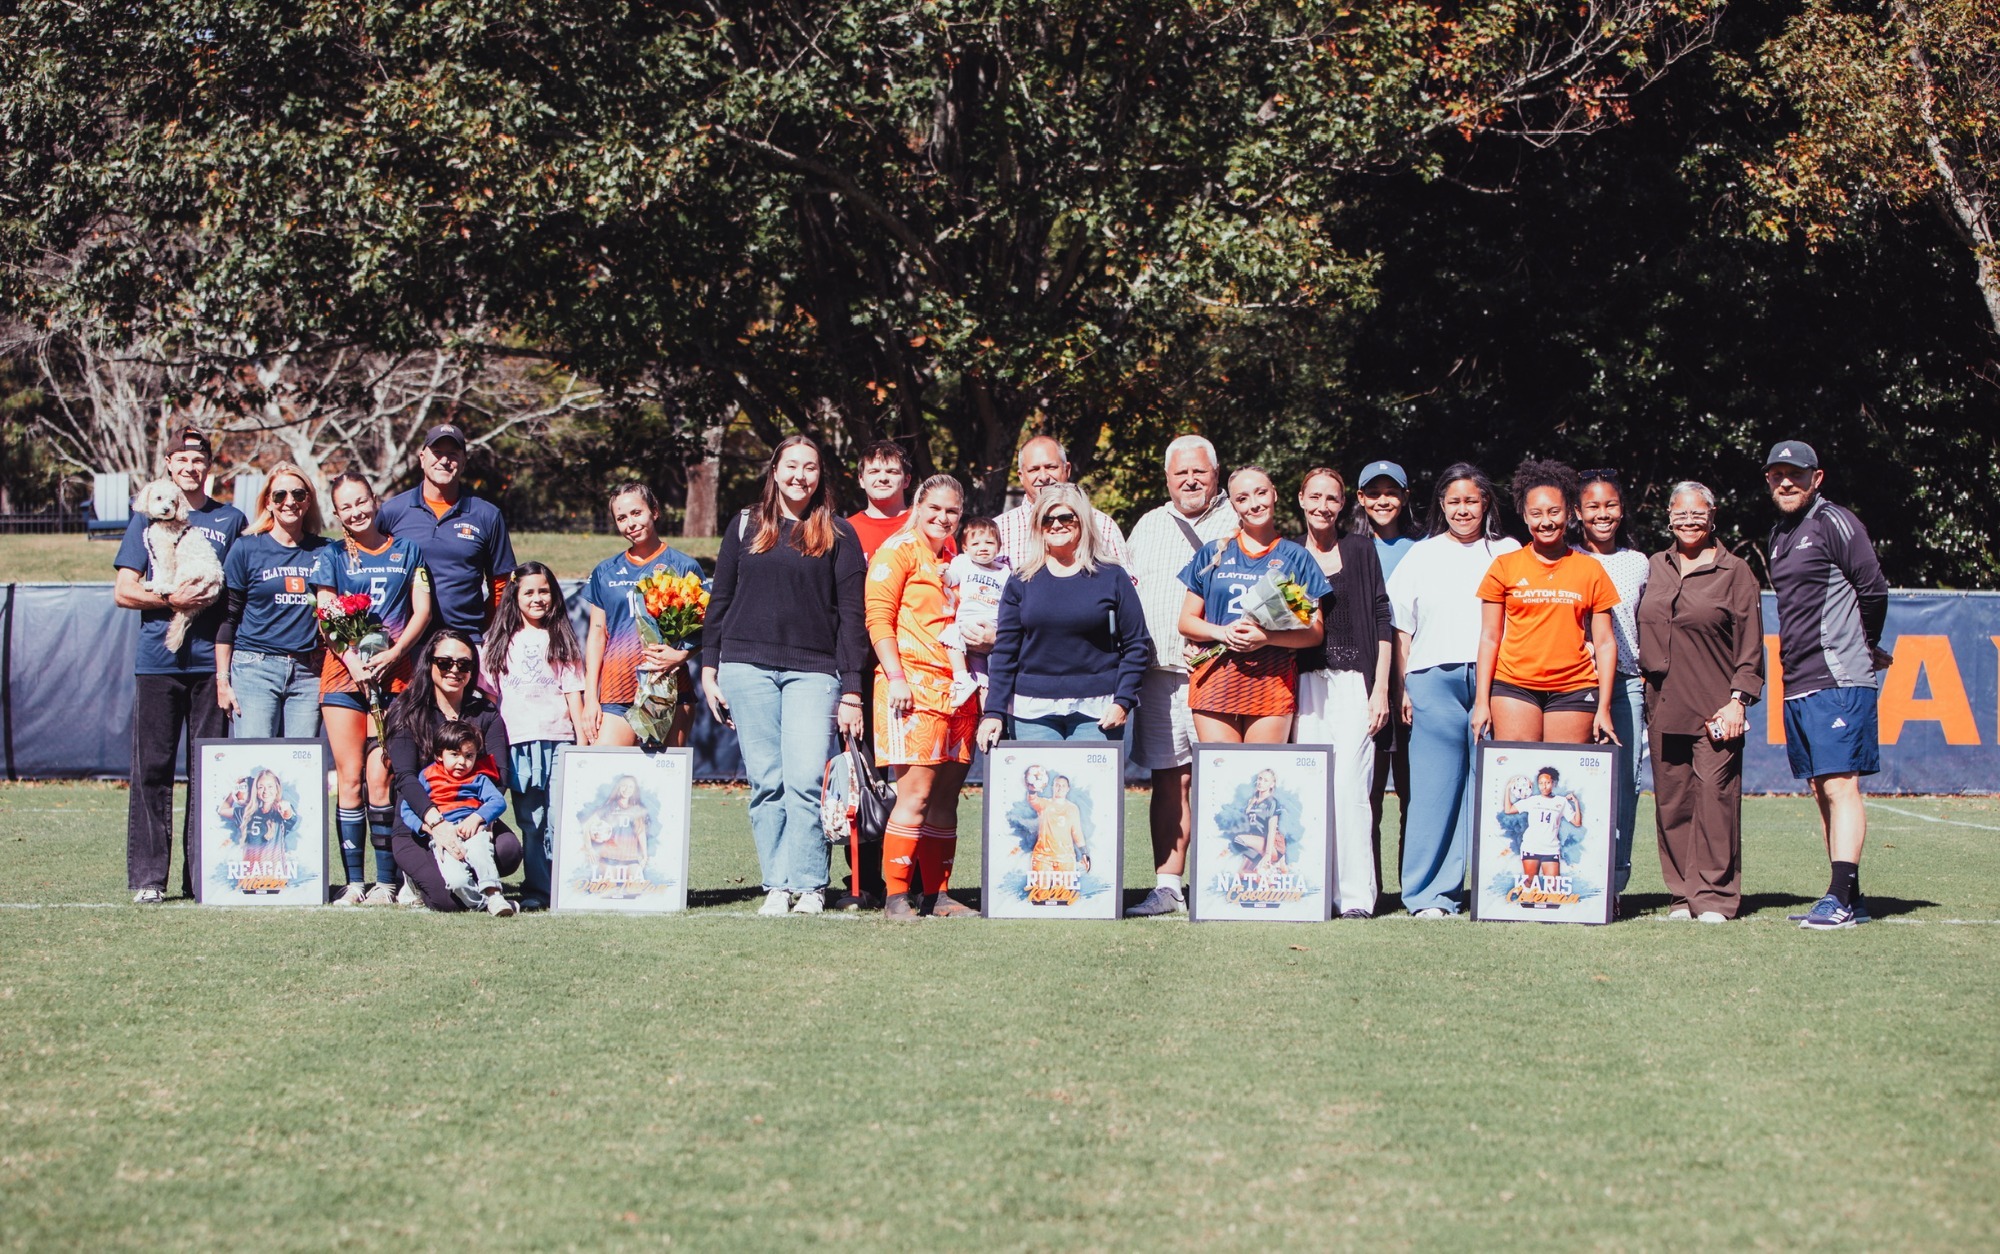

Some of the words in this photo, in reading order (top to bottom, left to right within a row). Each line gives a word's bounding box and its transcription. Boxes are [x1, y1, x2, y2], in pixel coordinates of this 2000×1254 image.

[262, 566, 297, 581] CLAYTON
[347, 567, 385, 576] CLAYTON
[1217, 572, 1257, 580] CLAYTON
[291, 578, 299, 590] 5
[608, 580, 638, 588] CLAYTO
[370, 577, 388, 606] 5
[1512, 589, 1556, 598] CLAYTON
[1558, 590, 1582, 602] STATE
[274, 594, 308, 605] SOCCE
[293, 751, 312, 760] 2026
[1087, 755, 1107, 763] 2026
[656, 760, 675, 768] 2026
[1296, 758, 1316, 767] 2026
[1580, 758, 1600, 767] 2026
[1540, 811, 1552, 824] 14
[252, 821, 261, 836] 5
[227, 861, 299, 880] REAGAN
[1216, 872, 1308, 893] NATASHA
[1514, 874, 1573, 895] KARIS
[1024, 885, 1080, 906] Kelley
